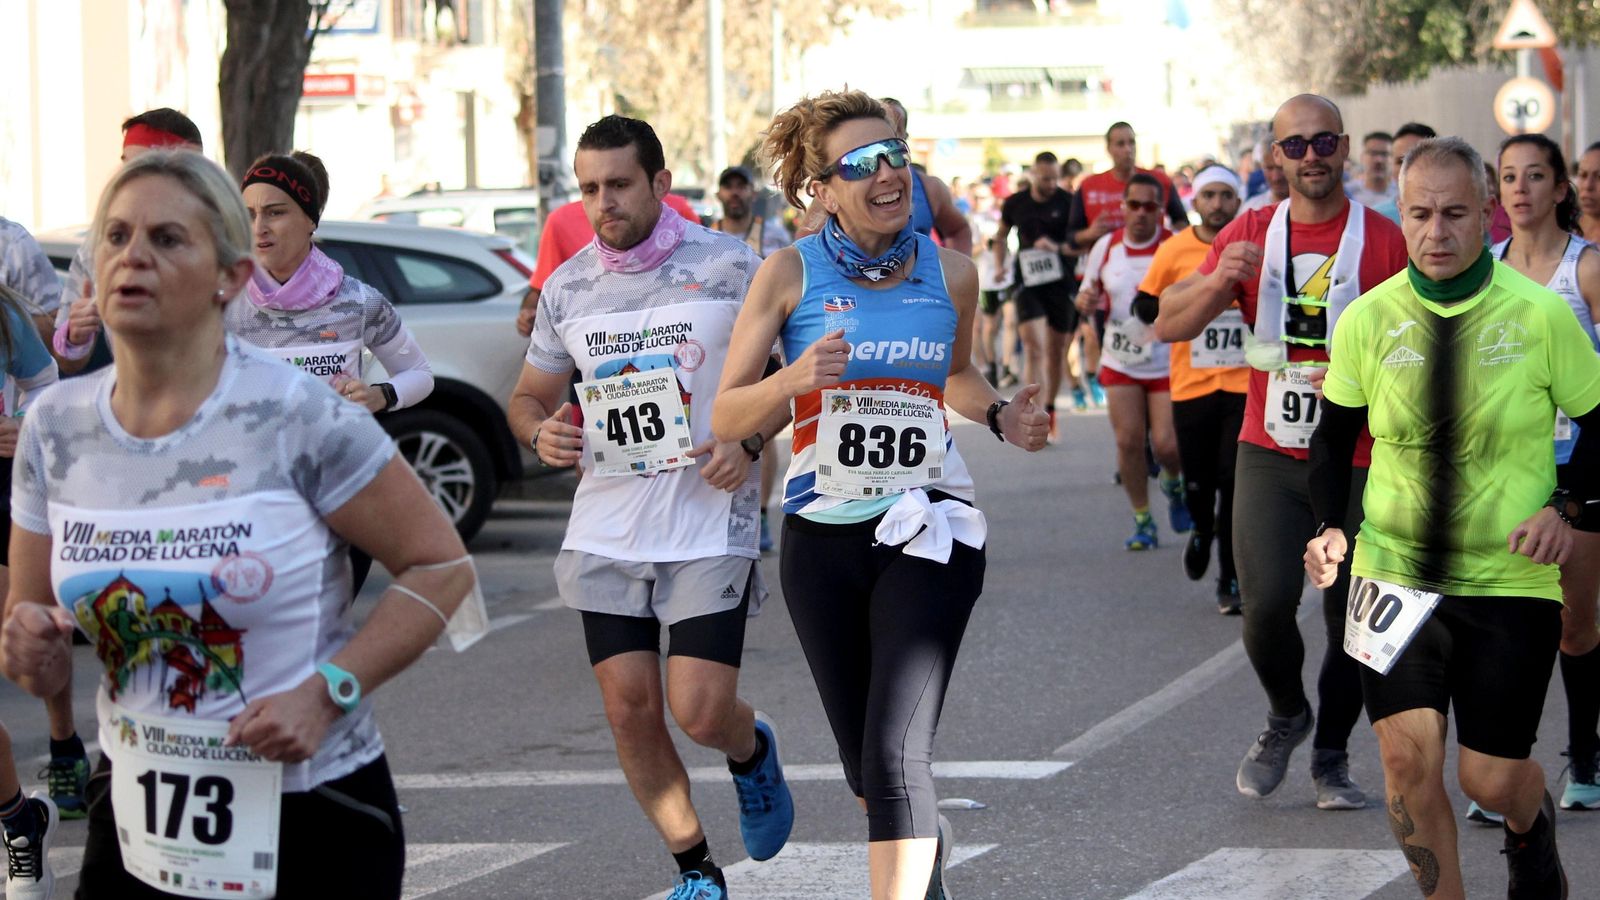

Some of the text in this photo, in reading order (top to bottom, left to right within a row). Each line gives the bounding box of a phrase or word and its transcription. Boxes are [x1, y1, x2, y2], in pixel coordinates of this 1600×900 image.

[1506, 98, 1540, 118] 30
[586, 322, 692, 347] VIII MEDIA MARATÓN
[589, 333, 688, 357] CIUDAD DE LUCENA
[1205, 328, 1242, 350] 874
[294, 353, 346, 367] MARATÓN
[602, 383, 616, 394] VIII
[637, 377, 669, 388] MARATÓN
[1289, 370, 1301, 379] VIII
[606, 384, 668, 400] CIUDAD DE LUCENA
[856, 396, 935, 413] VIII MEDIA MARATÓN
[858, 407, 933, 419] CIUDAD DE LUCENA
[607, 402, 665, 447] 413
[837, 422, 927, 469] 836
[62, 520, 252, 546] VIII MEDIA MARATÓN
[60, 541, 240, 563] CIUDAD DE LUCENA
[1348, 576, 1403, 634] 400
[142, 725, 165, 743] VIII
[167, 734, 204, 747] MEDIA
[146, 743, 262, 763] CIUDAD DE LUCENA
[137, 769, 235, 846] 173
